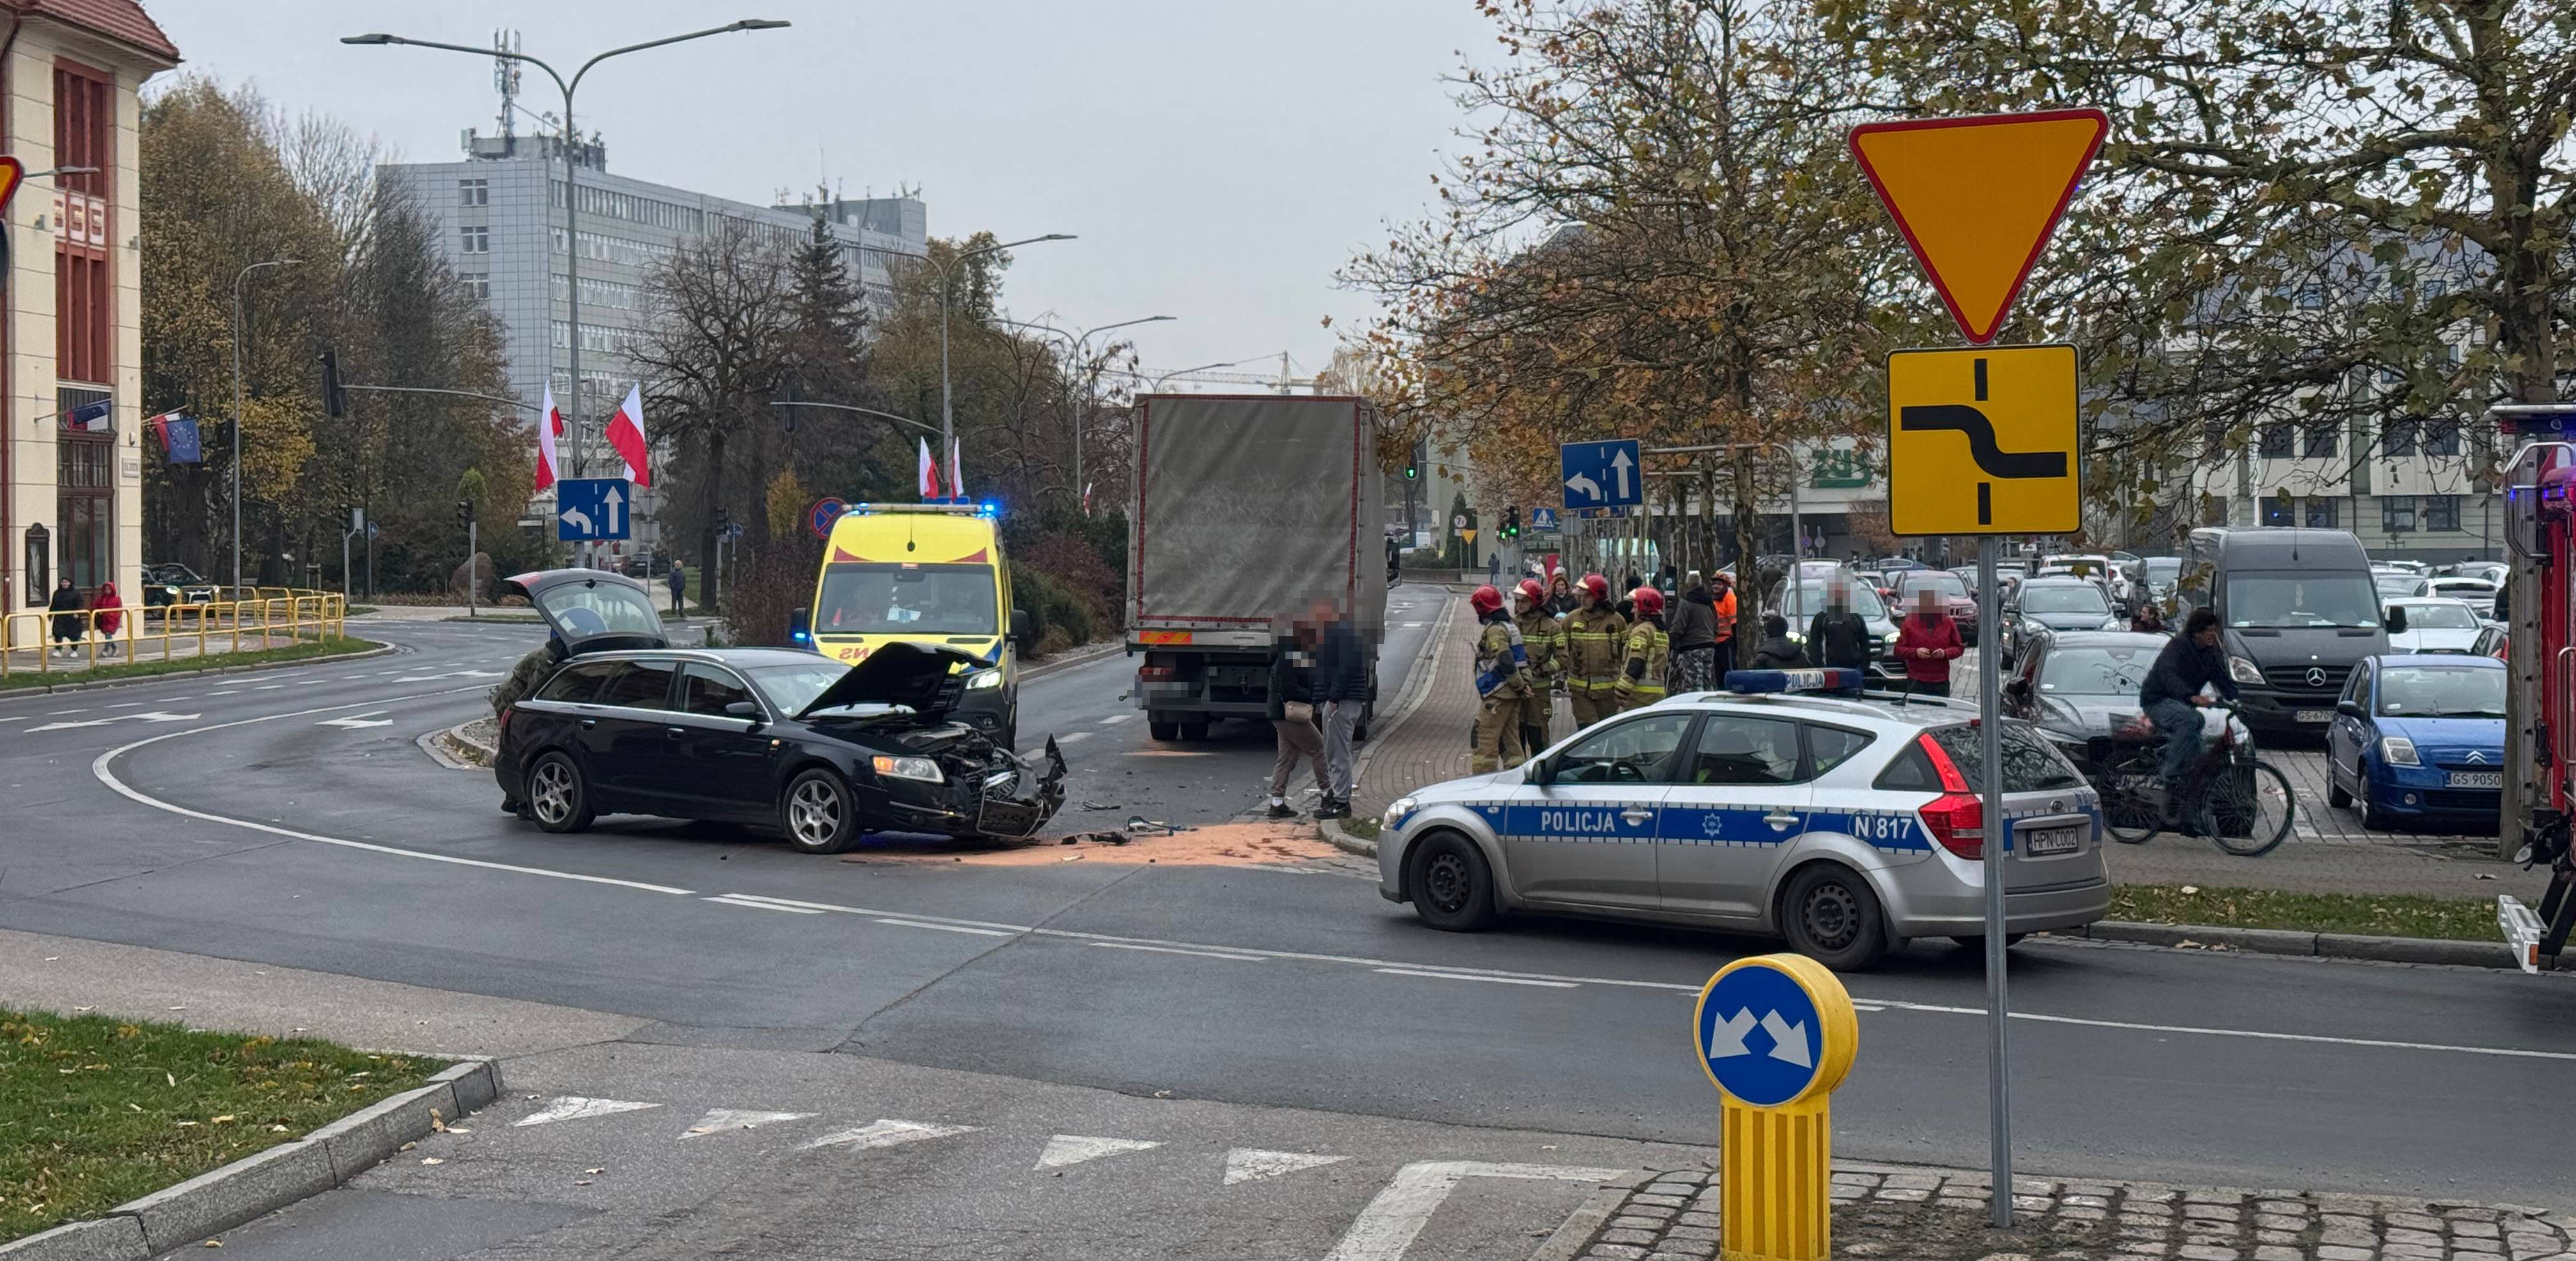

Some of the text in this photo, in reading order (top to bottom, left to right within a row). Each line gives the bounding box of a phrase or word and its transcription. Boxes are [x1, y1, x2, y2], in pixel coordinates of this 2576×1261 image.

[1786, 673, 1824, 688] POLICJA
[2299, 711, 2311, 720] GS
[2453, 774, 2468, 784] GS
[1541, 811, 1616, 832] POLICJA
[1855, 816, 1912, 839] N 817
